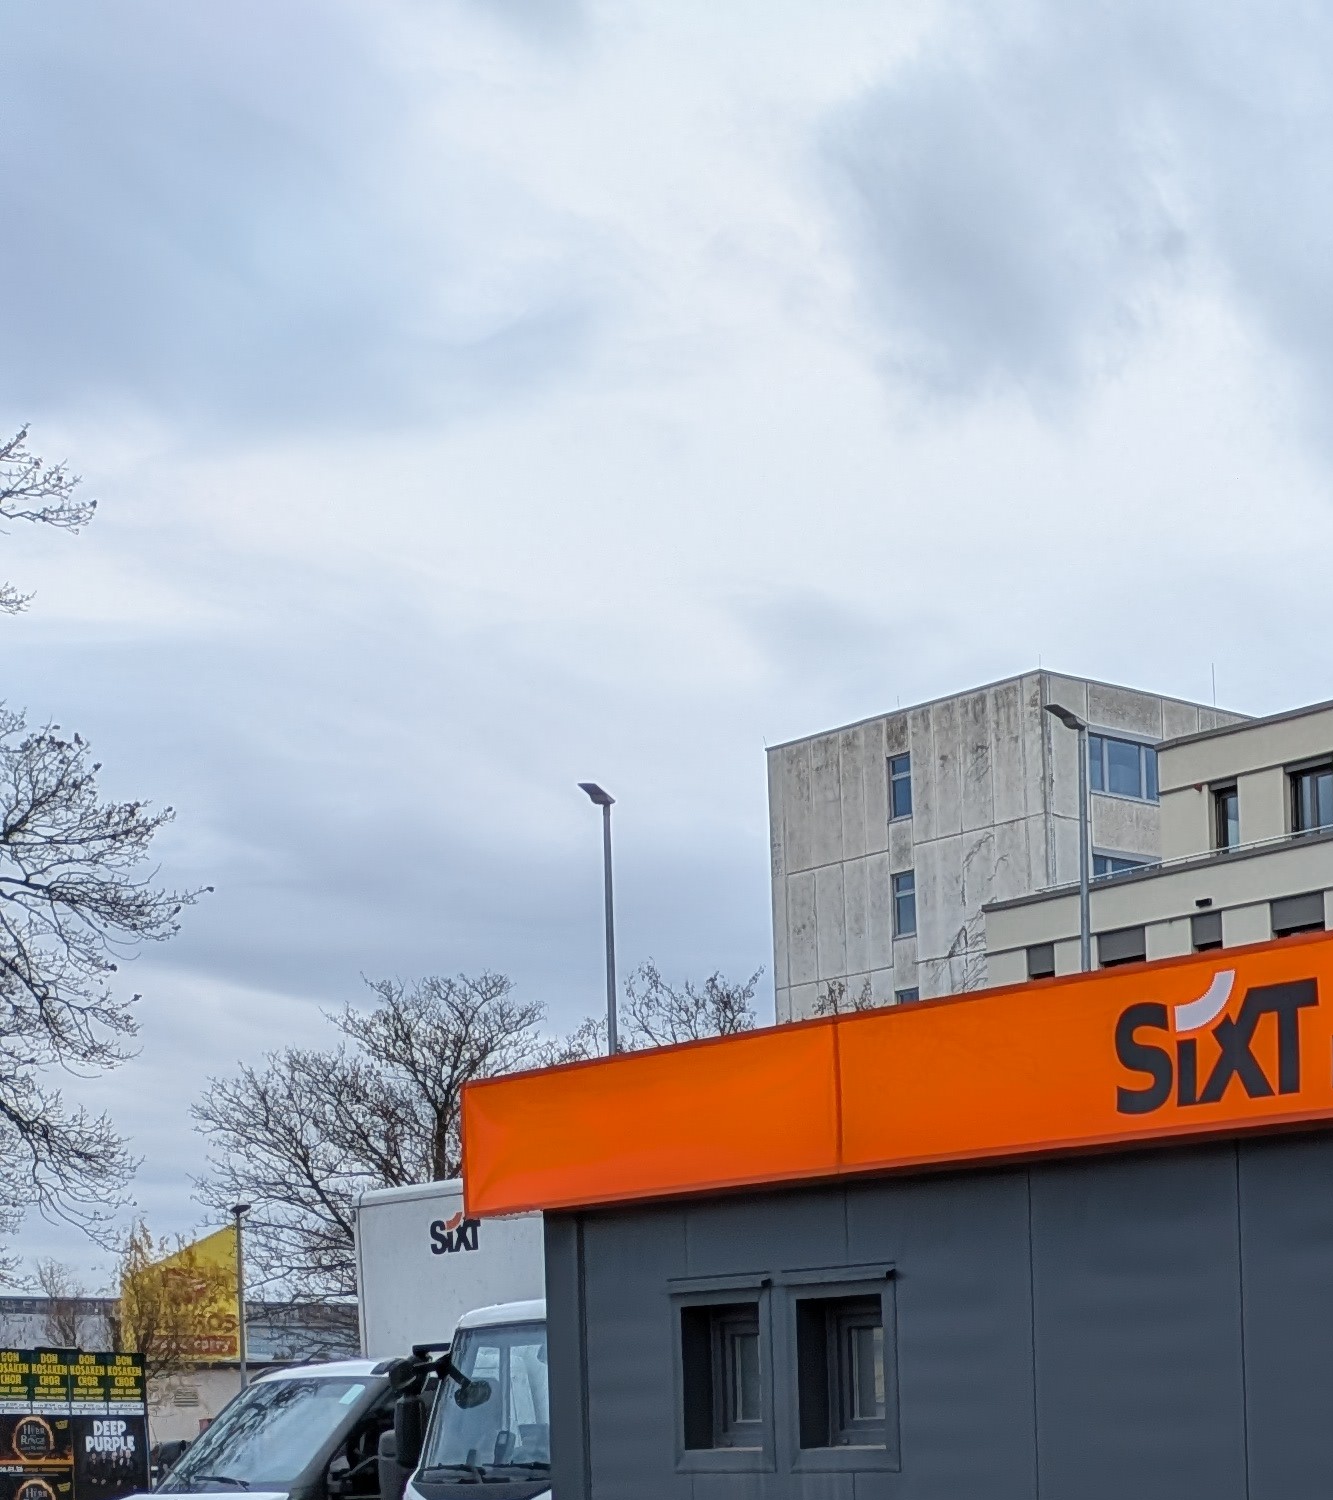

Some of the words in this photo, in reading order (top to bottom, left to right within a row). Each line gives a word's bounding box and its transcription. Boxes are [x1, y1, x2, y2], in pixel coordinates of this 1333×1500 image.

[0, 1364, 29, 1374] OSAKEN
[93, 1420, 127, 1436] DEEP
[85, 1435, 136, 1453] PURPLE
